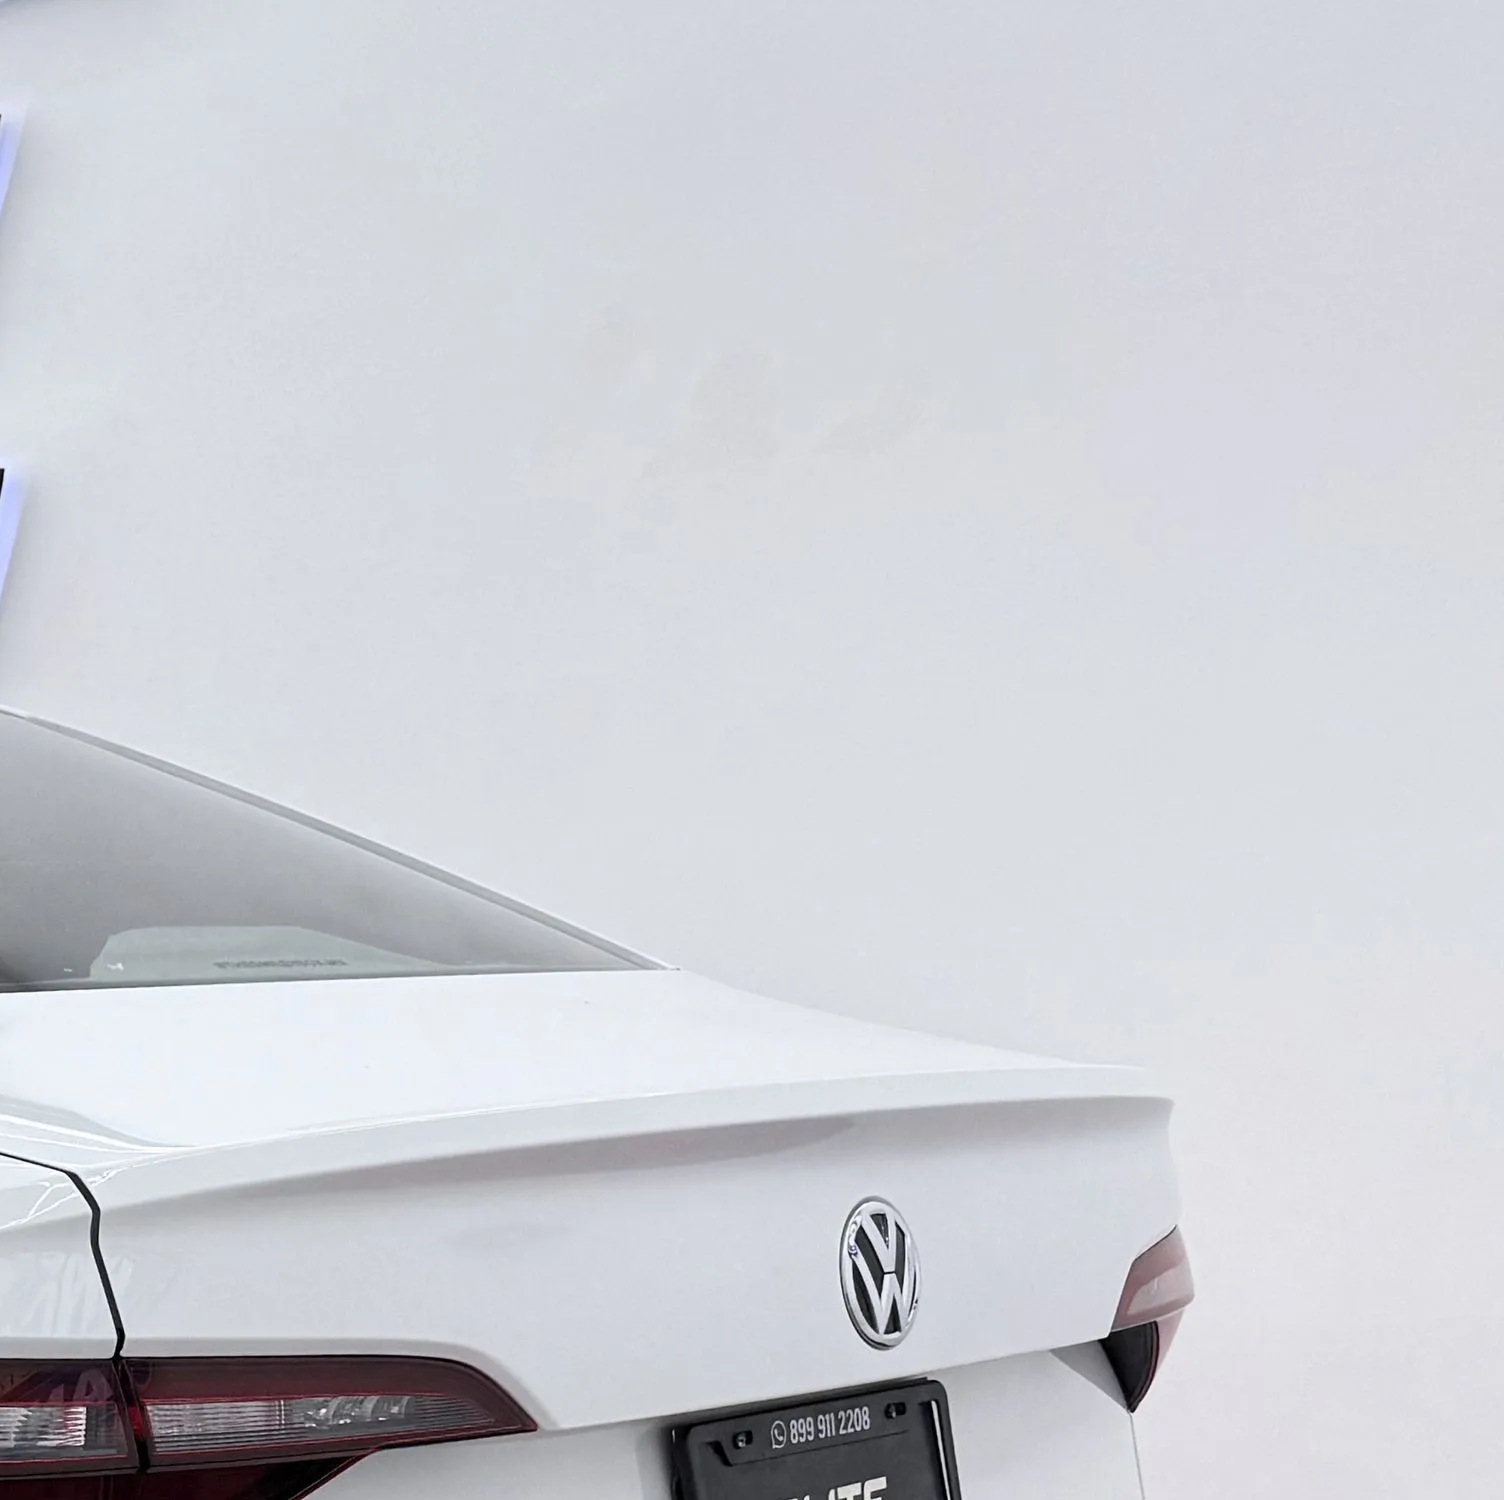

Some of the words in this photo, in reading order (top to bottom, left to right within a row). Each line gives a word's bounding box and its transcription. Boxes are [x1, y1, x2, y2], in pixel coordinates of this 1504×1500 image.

[789, 1417, 814, 1444] 899
[817, 1413, 836, 1439] 911
[838, 1406, 871, 1435] 2208
